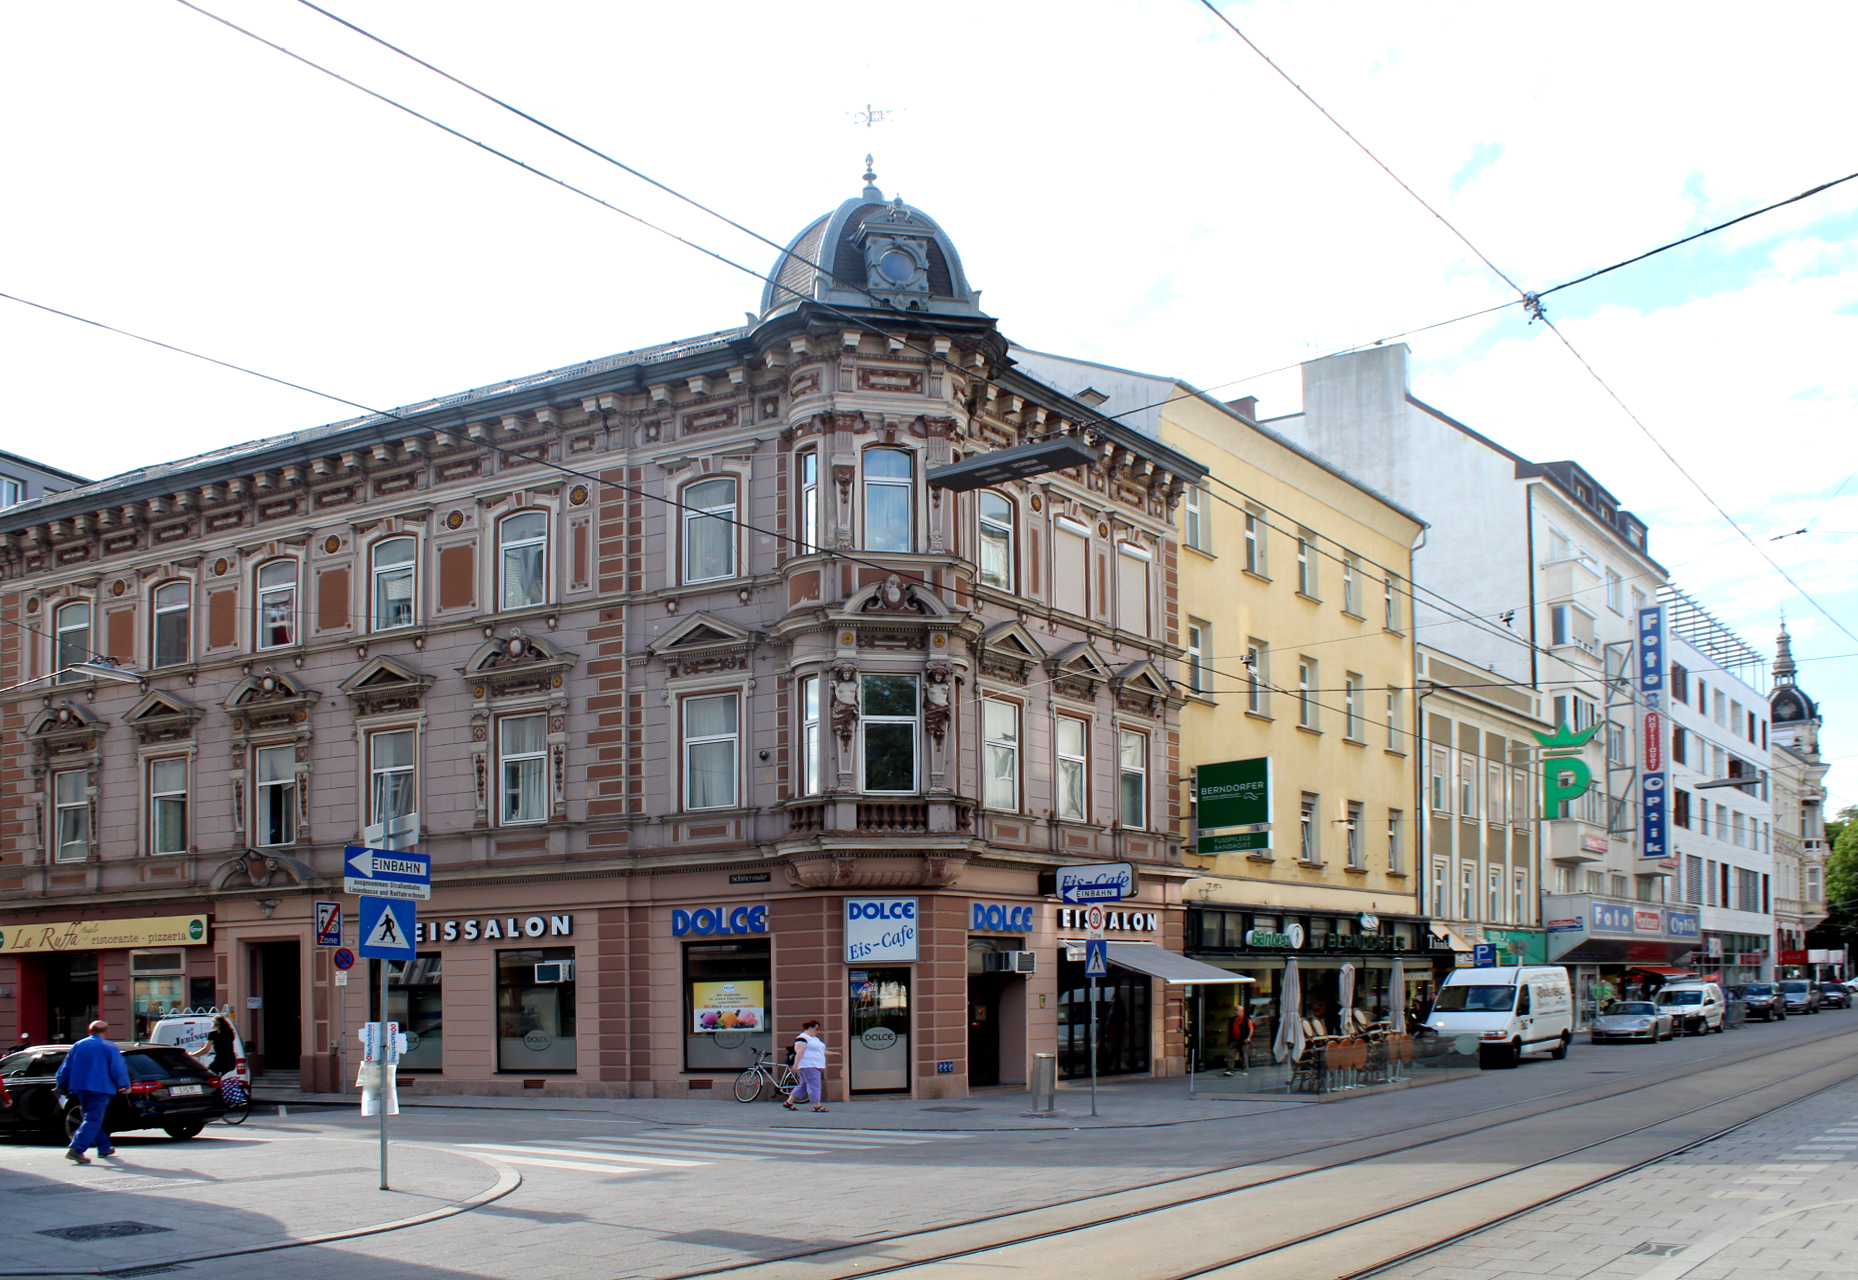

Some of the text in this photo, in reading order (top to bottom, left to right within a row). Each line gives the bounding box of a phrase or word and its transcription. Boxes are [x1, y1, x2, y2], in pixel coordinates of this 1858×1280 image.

[1641, 612, 1660, 686] Foto
[1647, 714, 1657, 770] Hartlauer
[1201, 781, 1264, 795] BERNDORFER
[1643, 777, 1664, 853] Optik
[1214, 834, 1251, 843] FUSSPFLEGE
[1214, 841, 1251, 850] BANDAGIST
[372, 858, 421, 874] EINBAHN
[349, 886, 378, 895] Linienbusse
[353, 879, 389, 888] ausgenommen
[1076, 889, 1113, 898] EINBAHN
[849, 902, 915, 920] DOLCE
[973, 902, 1033, 932] DOLCE
[1092, 912, 1099, 924] 30
[1594, 906, 1630, 928] Foto
[415, 915, 571, 942] EISSALON
[671, 904, 768, 937] DOLCE
[1670, 916, 1697, 935] Optik
[11, 929, 34, 950] La
[39, 921, 82, 950] Ruffa
[91, 930, 139, 945] ristorante
[148, 932, 187, 944] pizzeria
[320, 935, 338, 944] Zone
[849, 924, 915, 960] Eis-Cafe
[1252, 930, 1290, 947] Ganter
[1477, 945, 1490, 960] P
[526, 1036, 549, 1044] DOLCE
[865, 1033, 894, 1041] DOLCE
